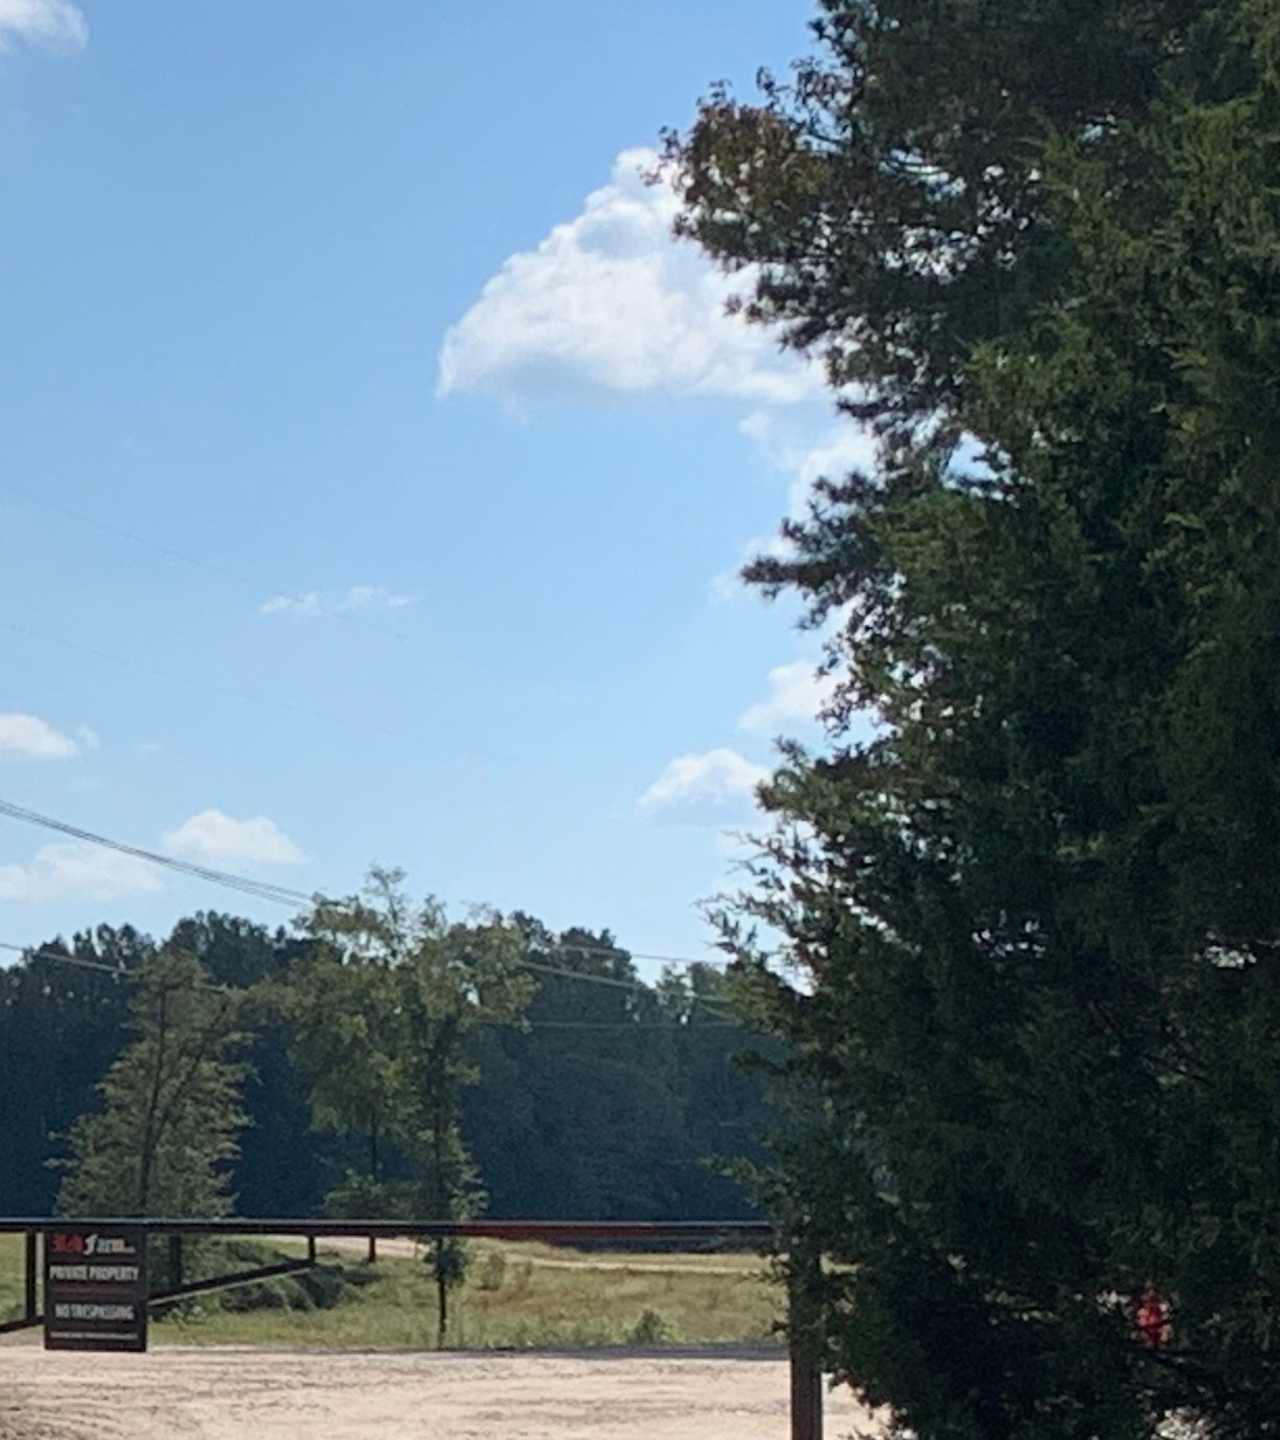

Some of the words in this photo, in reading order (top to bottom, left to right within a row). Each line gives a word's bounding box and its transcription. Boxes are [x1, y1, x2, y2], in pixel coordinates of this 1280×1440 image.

[49, 1265, 88, 1280] PRIVATE
[89, 1265, 139, 1281] PROPERTY
[55, 1303, 69, 1318] NO
[70, 1303, 135, 1320] TRESPASSING
